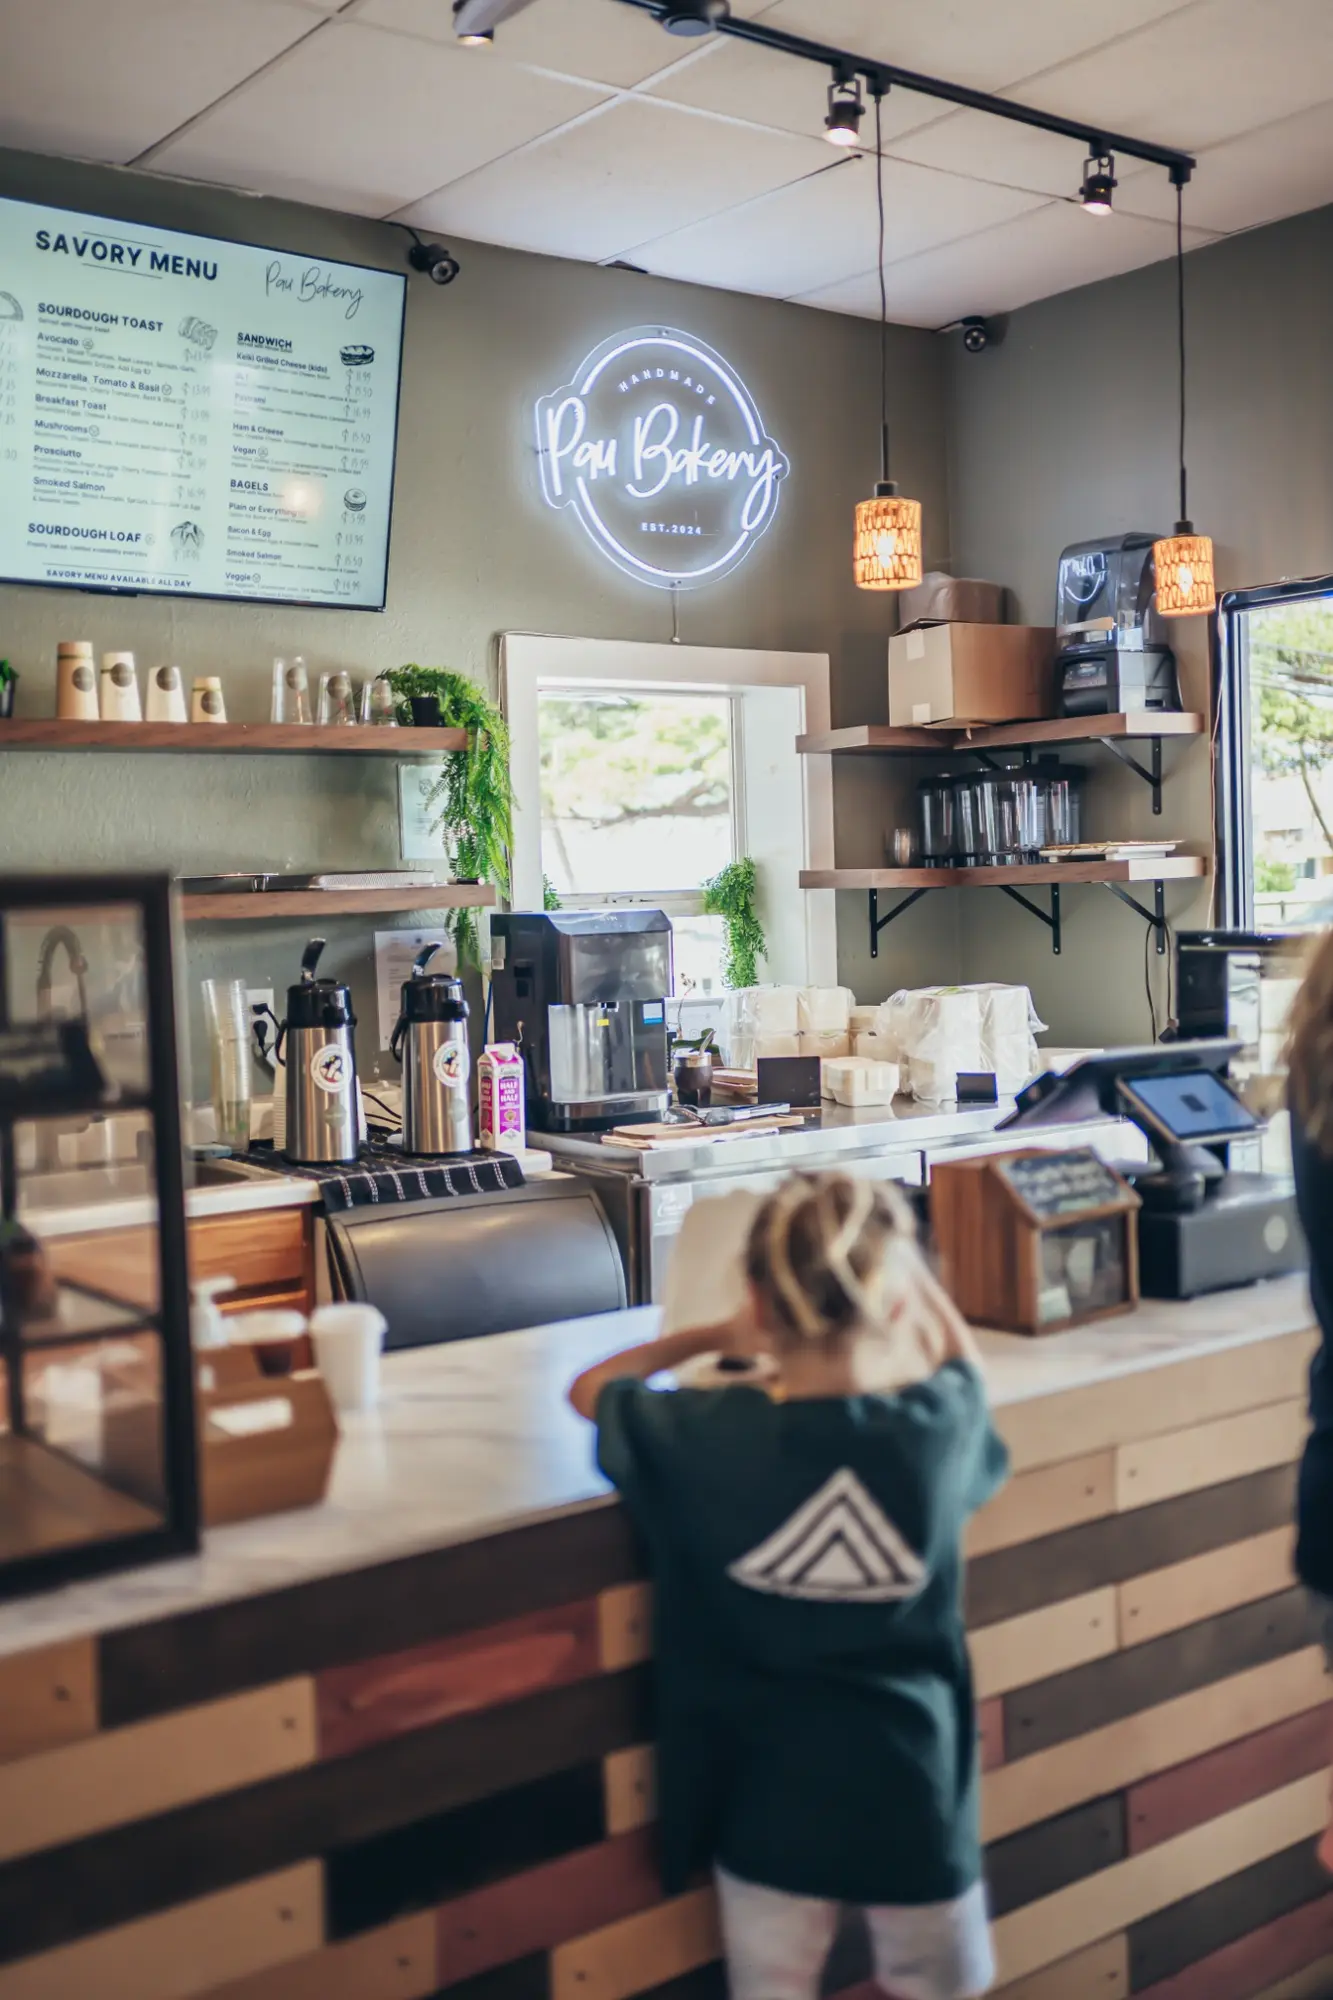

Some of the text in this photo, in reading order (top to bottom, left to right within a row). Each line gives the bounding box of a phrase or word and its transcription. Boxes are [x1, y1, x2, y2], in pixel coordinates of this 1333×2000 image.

[36, 230, 217, 281] SAVORY MENU
[267, 260, 363, 320] Pau Bakery
[38, 302, 118, 325] SOURDOUGH
[122, 316, 163, 333] TOAST
[38, 332, 79, 346] Avocado
[237, 332, 292, 349] SANDWICH
[256, 355, 279, 365] Grilled
[280, 358, 307, 370] Cheese
[93, 376, 128, 389] Tomato
[130, 381, 136, 389] &
[138, 382, 160, 393] Basil
[617, 367, 716, 406] HANDMADE
[35, 394, 107, 411] Breakfast Toast
[34, 420, 88, 434] Mushrooms
[233, 422, 249, 433] Ham
[258, 426, 284, 436] Cheese
[34, 445, 82, 459] Prosciutto
[233, 444, 257, 456] Vegan
[547, 396, 783, 531] Pau Bakery
[33, 476, 106, 495] Smoked Salmon
[230, 479, 269, 492] BAGELS
[229, 502, 247, 511] Plain
[258, 505, 297, 519] Everything
[28, 523, 141, 545] SOURDOUGH LOAF
[228, 525, 250, 535] Bacon
[259, 529, 271, 538] Egg
[641, 521, 702, 535] EST.2024
[226, 549, 282, 562] Smoked Salmon
[46, 569, 192, 588] SAVORY MENU AVAILABLE ALL DAY
[225, 572, 250, 583] Veggie
[500, 1081, 518, 1090] HALF
[500, 1095, 518, 1104] HALF
